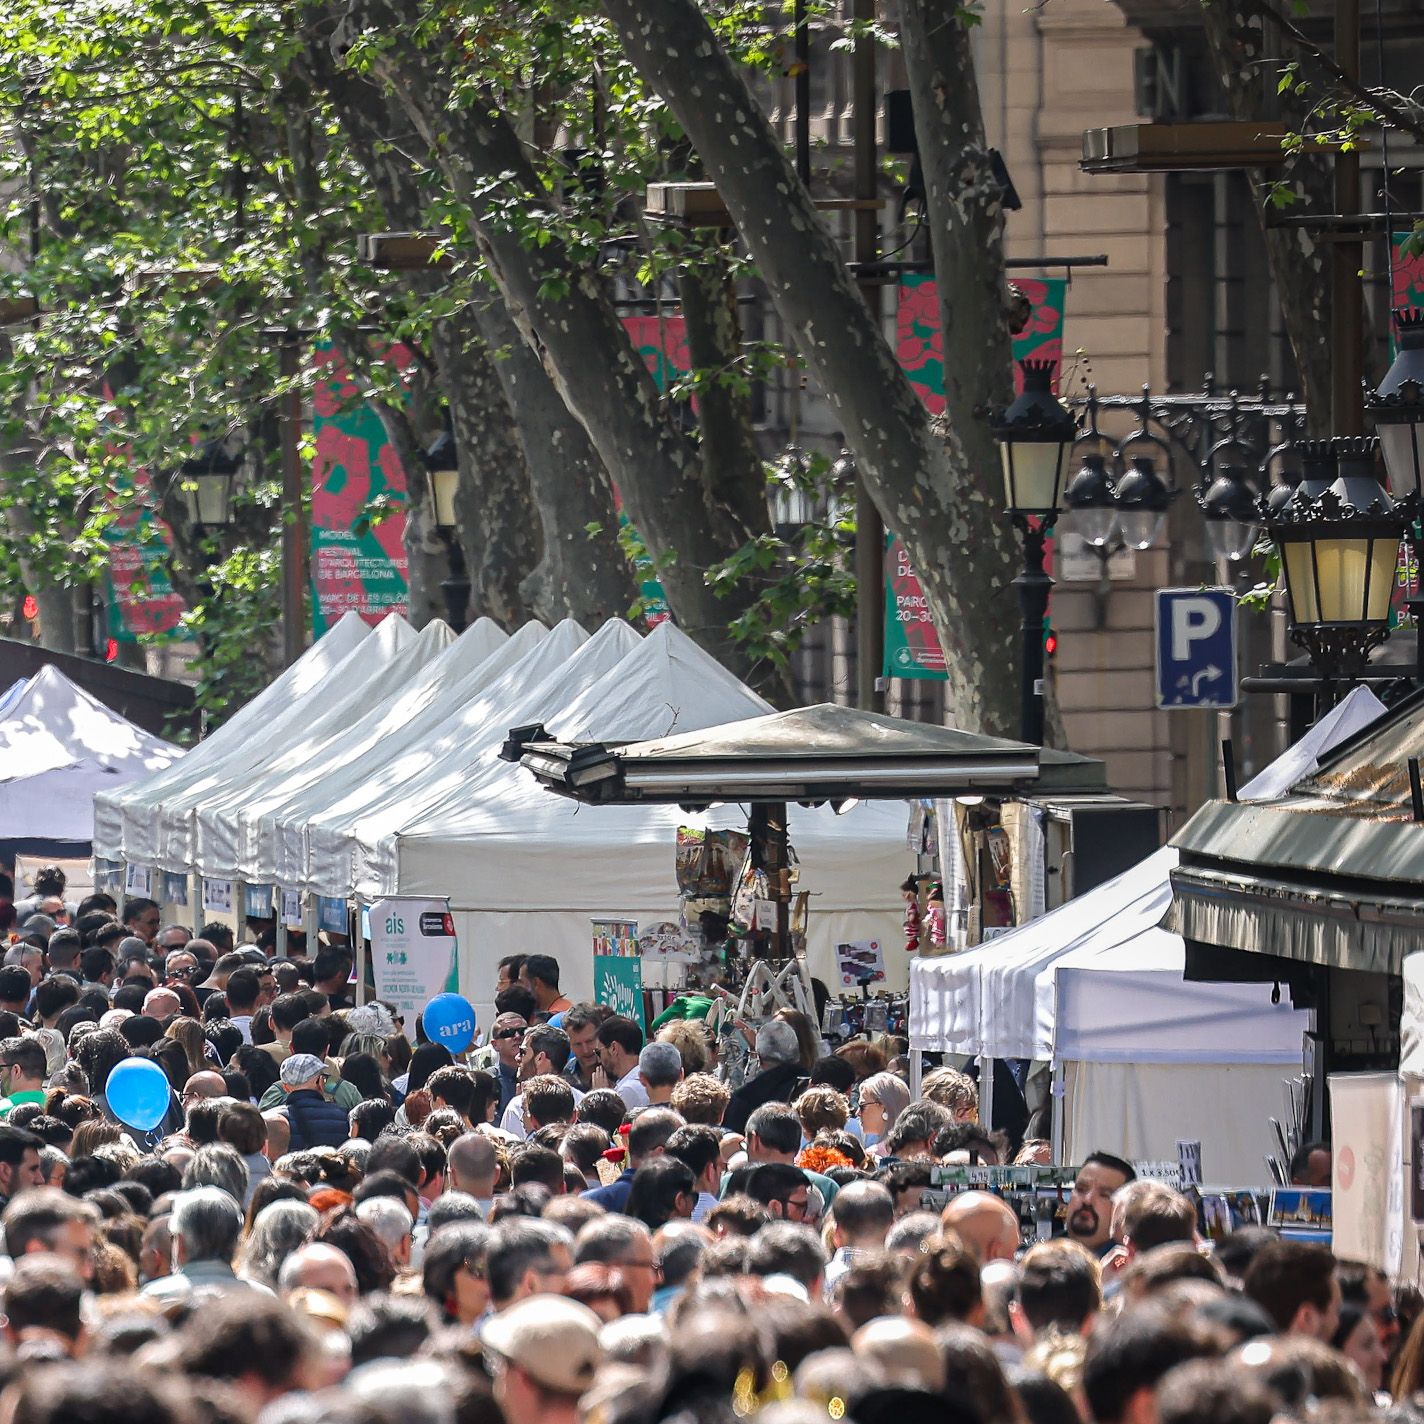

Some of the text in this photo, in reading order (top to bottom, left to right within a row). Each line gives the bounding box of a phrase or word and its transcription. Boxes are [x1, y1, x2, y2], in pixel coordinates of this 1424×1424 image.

[318, 547, 363, 557] FESTIVAL
[318, 569, 394, 579] DE BARCELONA
[1171, 597, 1221, 661] P
[385, 912, 404, 935] ais
[439, 1019, 471, 1038] ara
